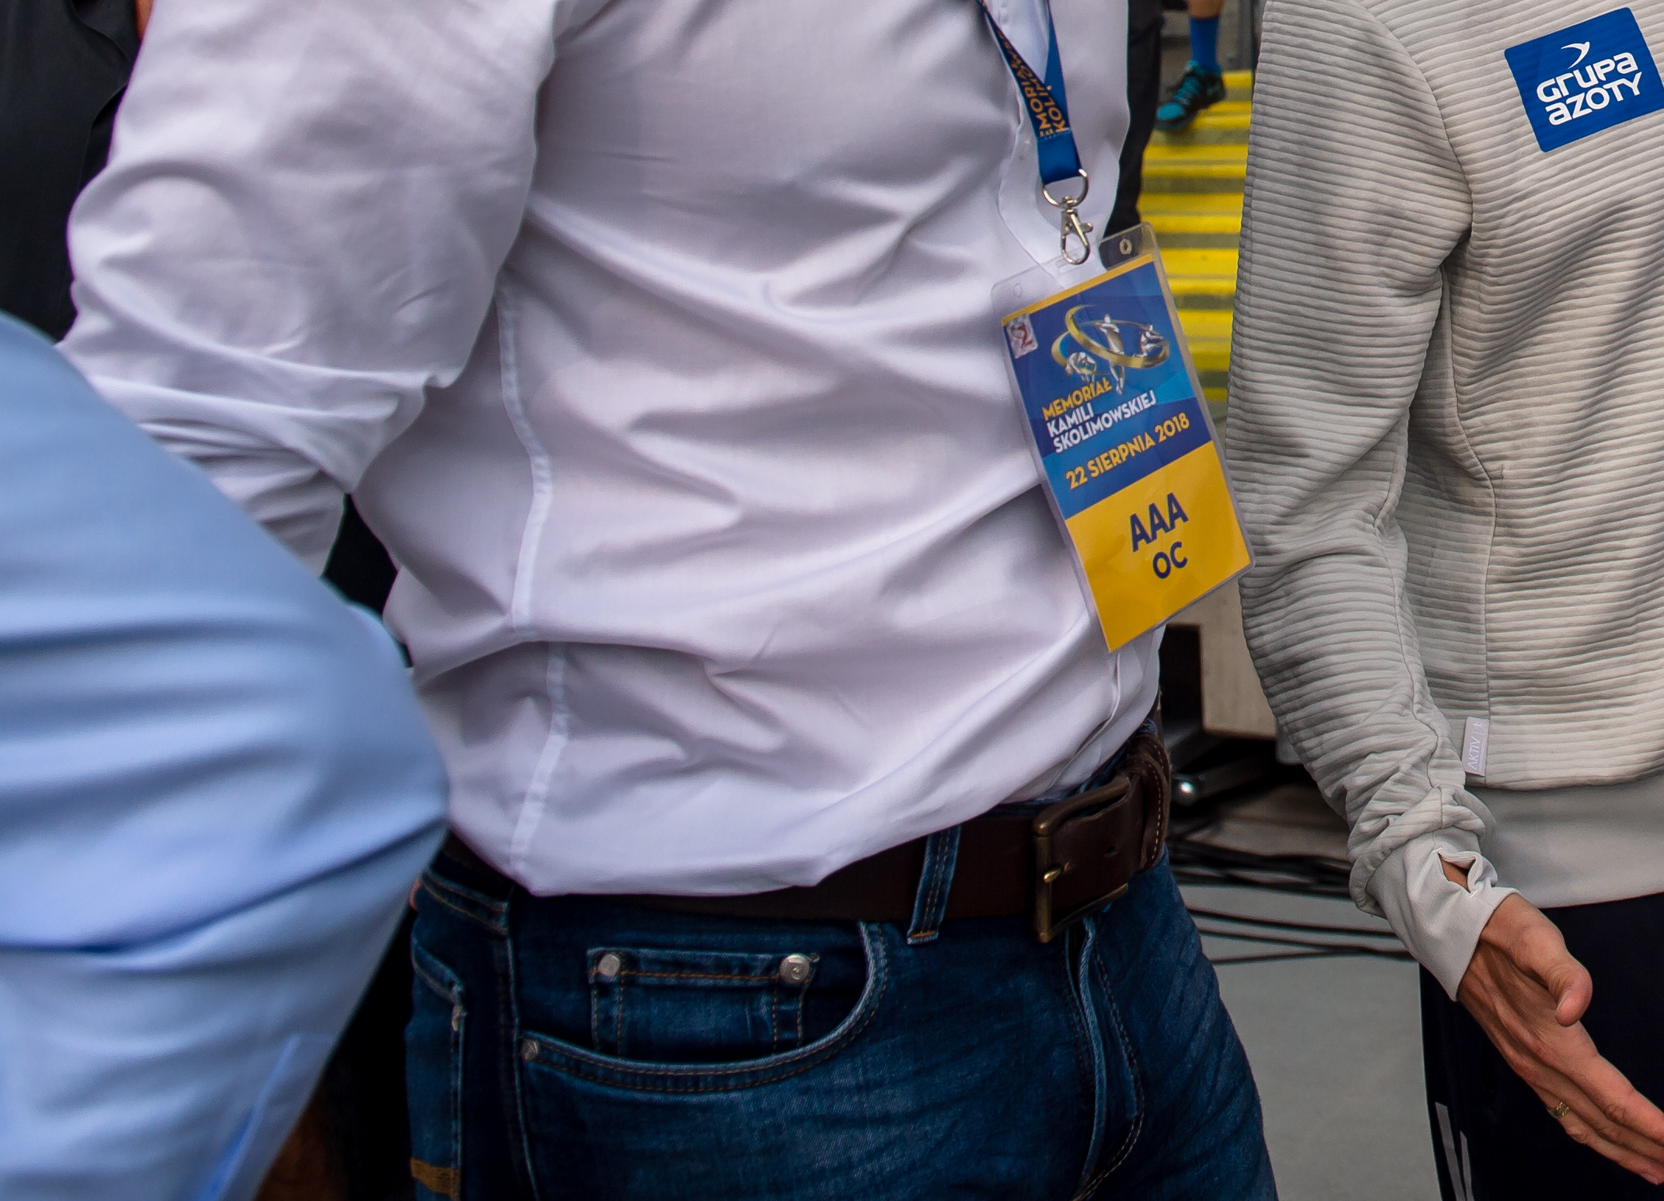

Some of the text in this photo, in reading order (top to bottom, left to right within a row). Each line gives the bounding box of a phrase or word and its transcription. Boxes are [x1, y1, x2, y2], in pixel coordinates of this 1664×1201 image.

[1042, 377, 1112, 421] MEMORIAŁ
[1047, 403, 1094, 437] KAMILI
[1053, 390, 1156, 453] SKOLIMOWSKIEJ
[1065, 413, 1190, 490] 22 SIERPNIA 2018
[1130, 492, 1189, 552] AAA
[1152, 541, 1188, 579] OC
